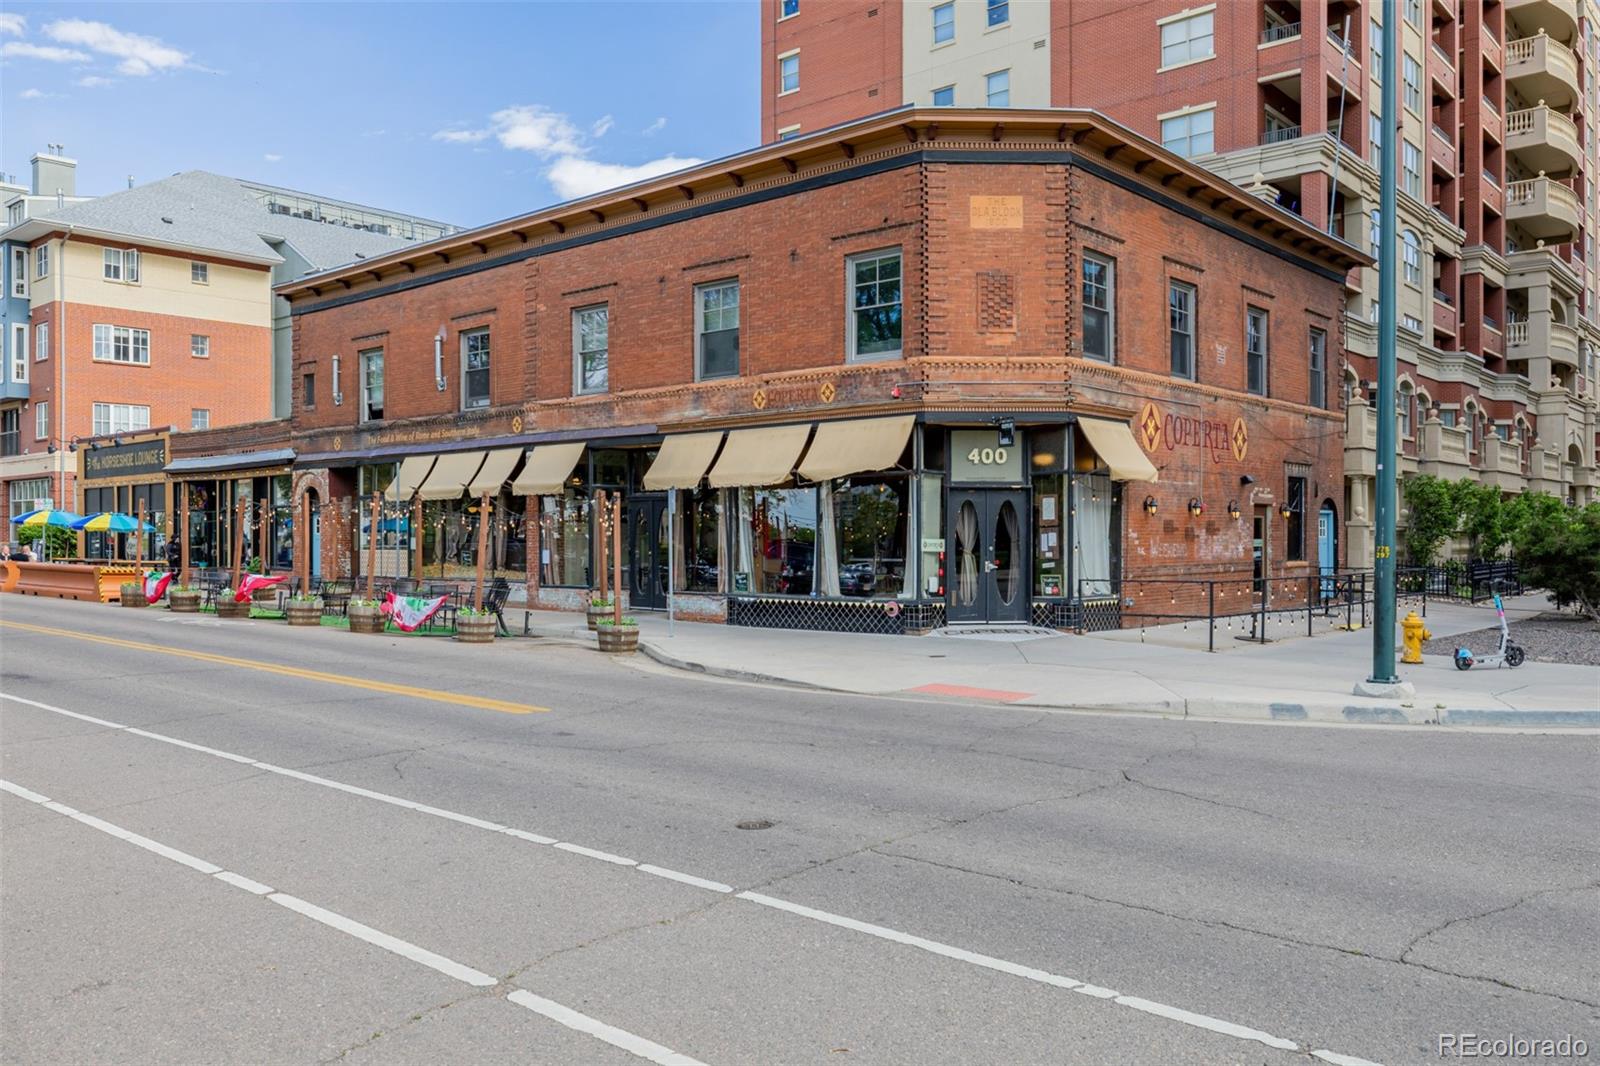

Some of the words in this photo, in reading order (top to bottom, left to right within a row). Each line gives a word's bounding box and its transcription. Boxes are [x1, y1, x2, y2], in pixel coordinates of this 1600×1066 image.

[992, 207, 1021, 217] BLOCK
[377, 433, 389, 444] Food
[1164, 413, 1231, 465] COPERTA
[101, 452, 134, 468] HORSESHOE
[134, 449, 159, 466] LOUNGE
[968, 448, 1008, 465] 400
